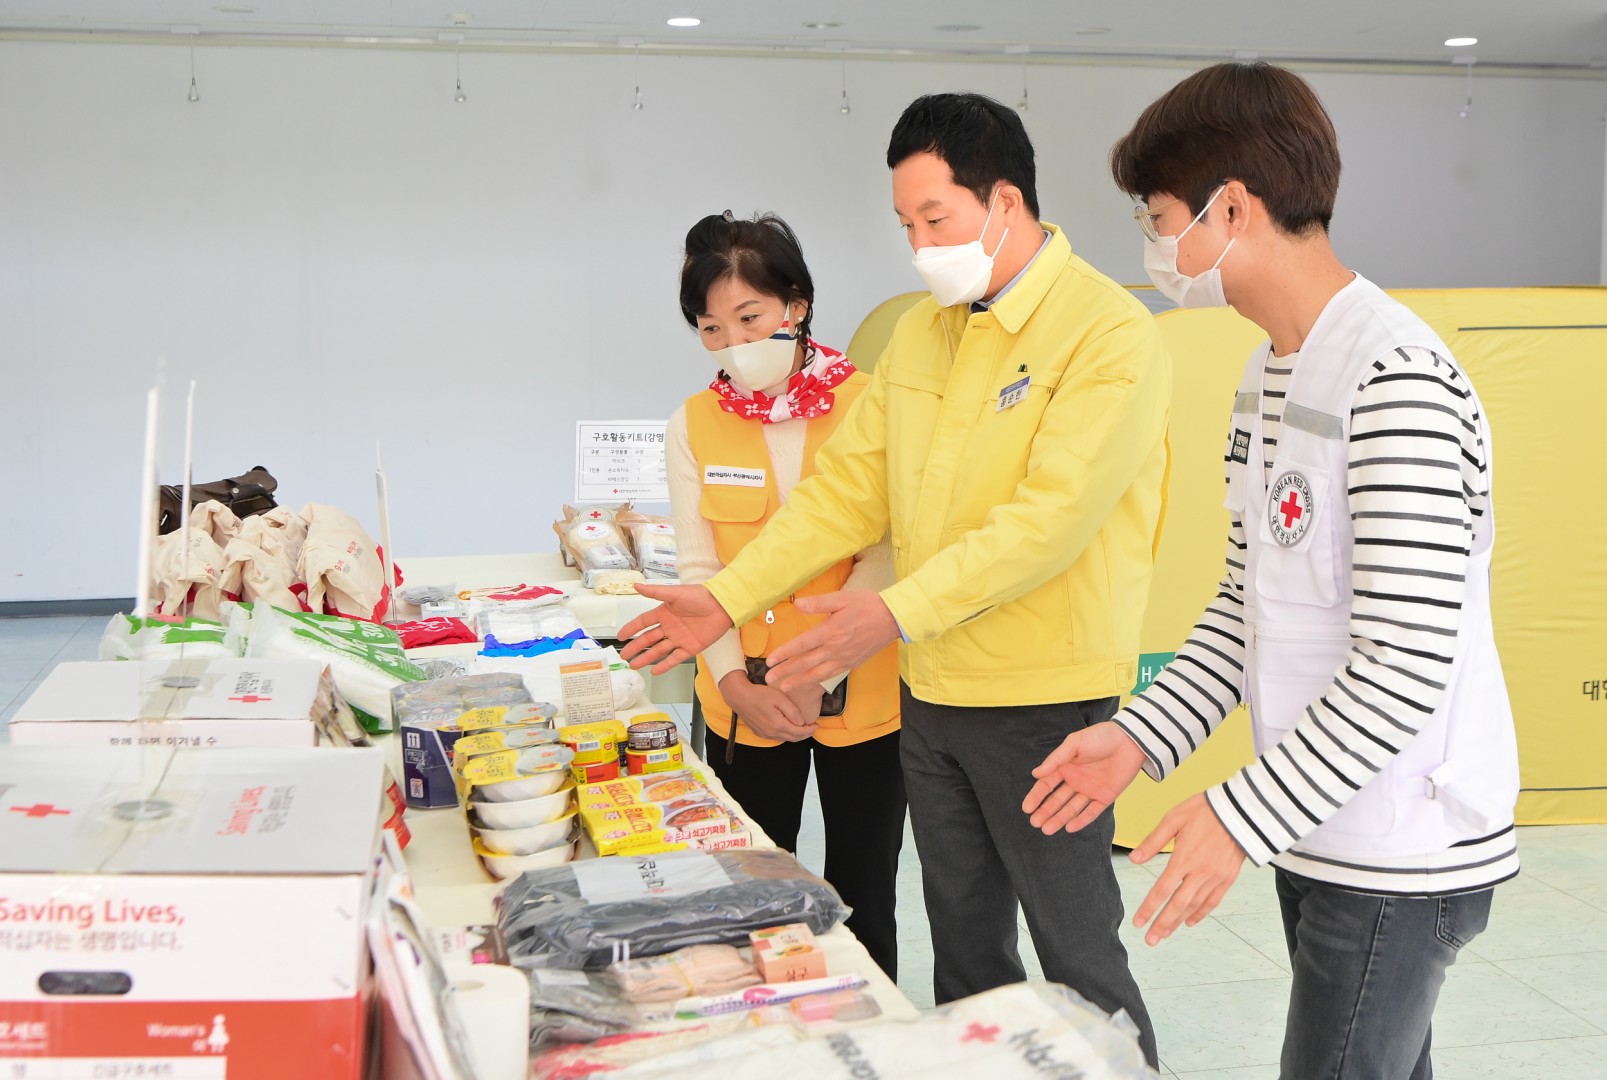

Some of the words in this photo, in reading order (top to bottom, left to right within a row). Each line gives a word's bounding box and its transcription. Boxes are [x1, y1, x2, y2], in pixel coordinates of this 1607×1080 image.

[1273, 475, 1293, 502] KOREAN
[1293, 475, 1304, 488] RED
[1302, 486, 1312, 514] CROSS
[0, 897, 94, 929] Saving
[104, 899, 185, 926] Lives,
